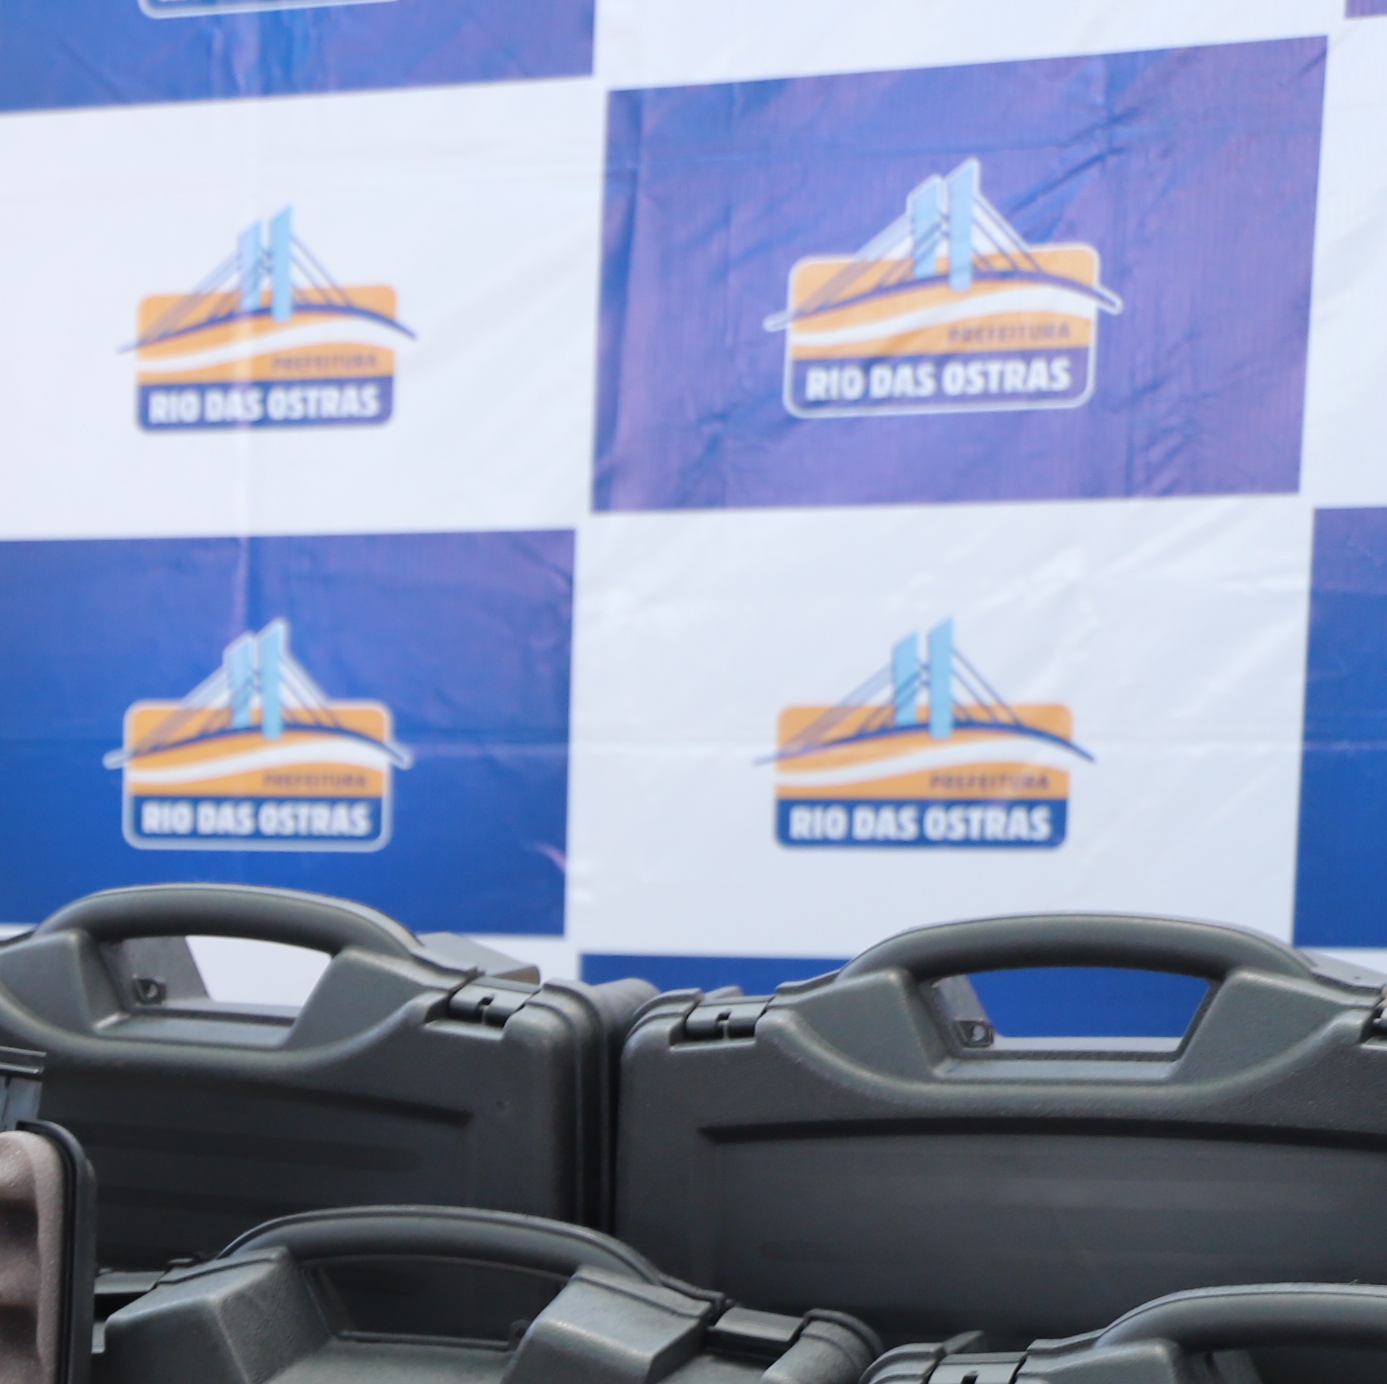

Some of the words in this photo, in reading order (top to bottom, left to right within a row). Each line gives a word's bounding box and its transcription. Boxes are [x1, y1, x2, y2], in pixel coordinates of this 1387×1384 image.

[805, 367, 865, 401] RIO
[869, 363, 937, 399] DAS
[942, 357, 1071, 396] OSTRAS
[148, 390, 201, 424] RIO
[204, 387, 263, 422] DAS
[267, 383, 380, 420] OSTRAS
[141, 800, 194, 835] RIO
[196, 800, 256, 836] DAS
[258, 801, 372, 837] OSTRAS
[788, 805, 848, 840] RIO
[852, 805, 919, 841] DAS
[923, 805, 1051, 842] OSTRAS
